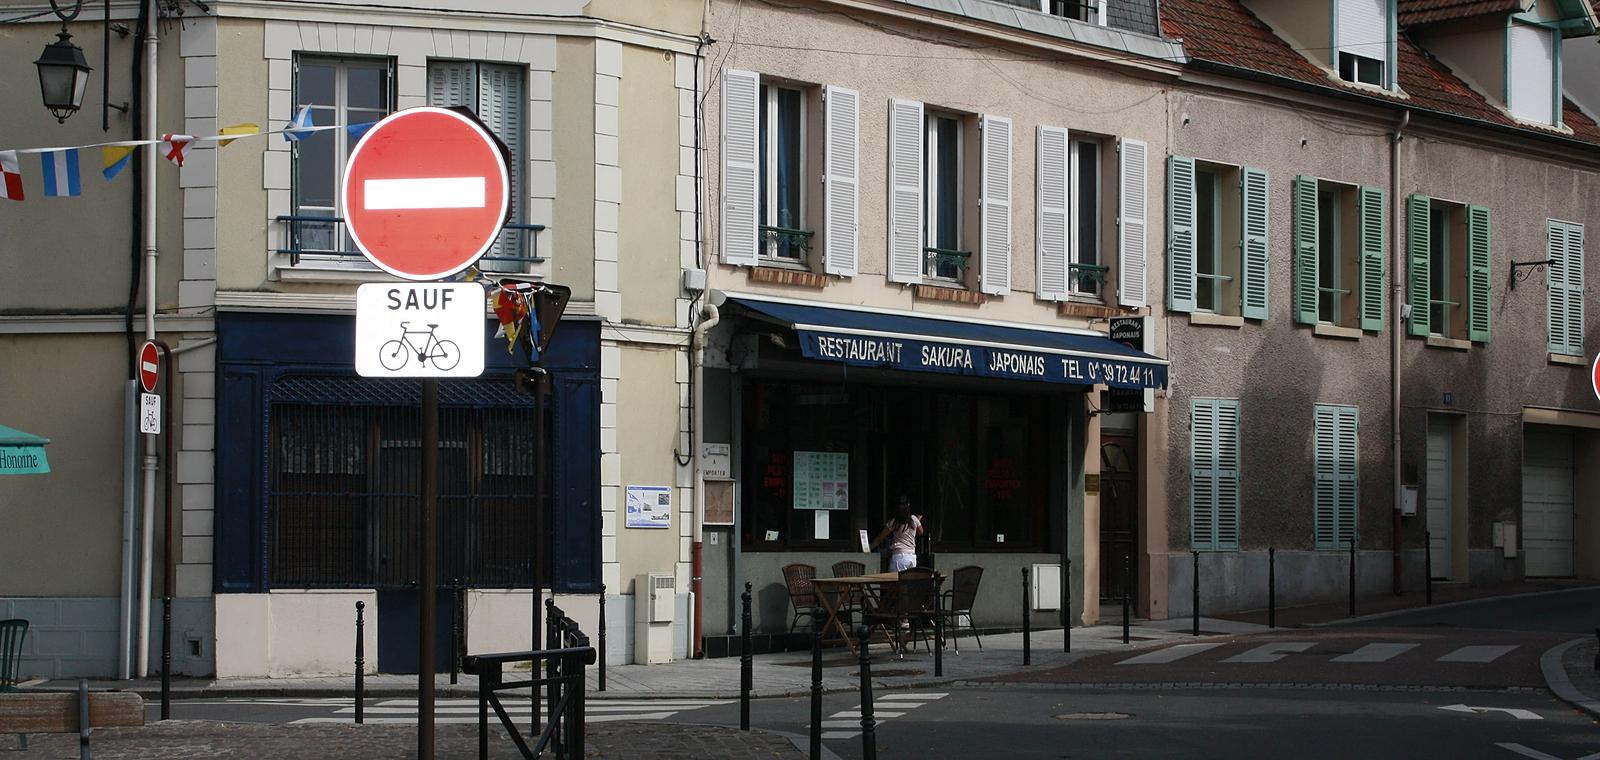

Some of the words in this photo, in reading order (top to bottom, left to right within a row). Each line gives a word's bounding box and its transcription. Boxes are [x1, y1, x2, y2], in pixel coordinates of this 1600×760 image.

[387, 288, 455, 310] SAUF
[1111, 319, 1142, 331] RESTAURANT
[1112, 330, 1140, 339] JAPONAIS
[818, 336, 903, 363] RESTAURANT
[921, 345, 973, 369] SAKURA
[989, 352, 1045, 375] JAPONAIS
[1062, 359, 1083, 379] TEL
[1102, 363, 1115, 382] 39
[1115, 364, 1128, 383] 72
[1129, 365, 1141, 385] 44
[1143, 367, 1154, 386] 11
